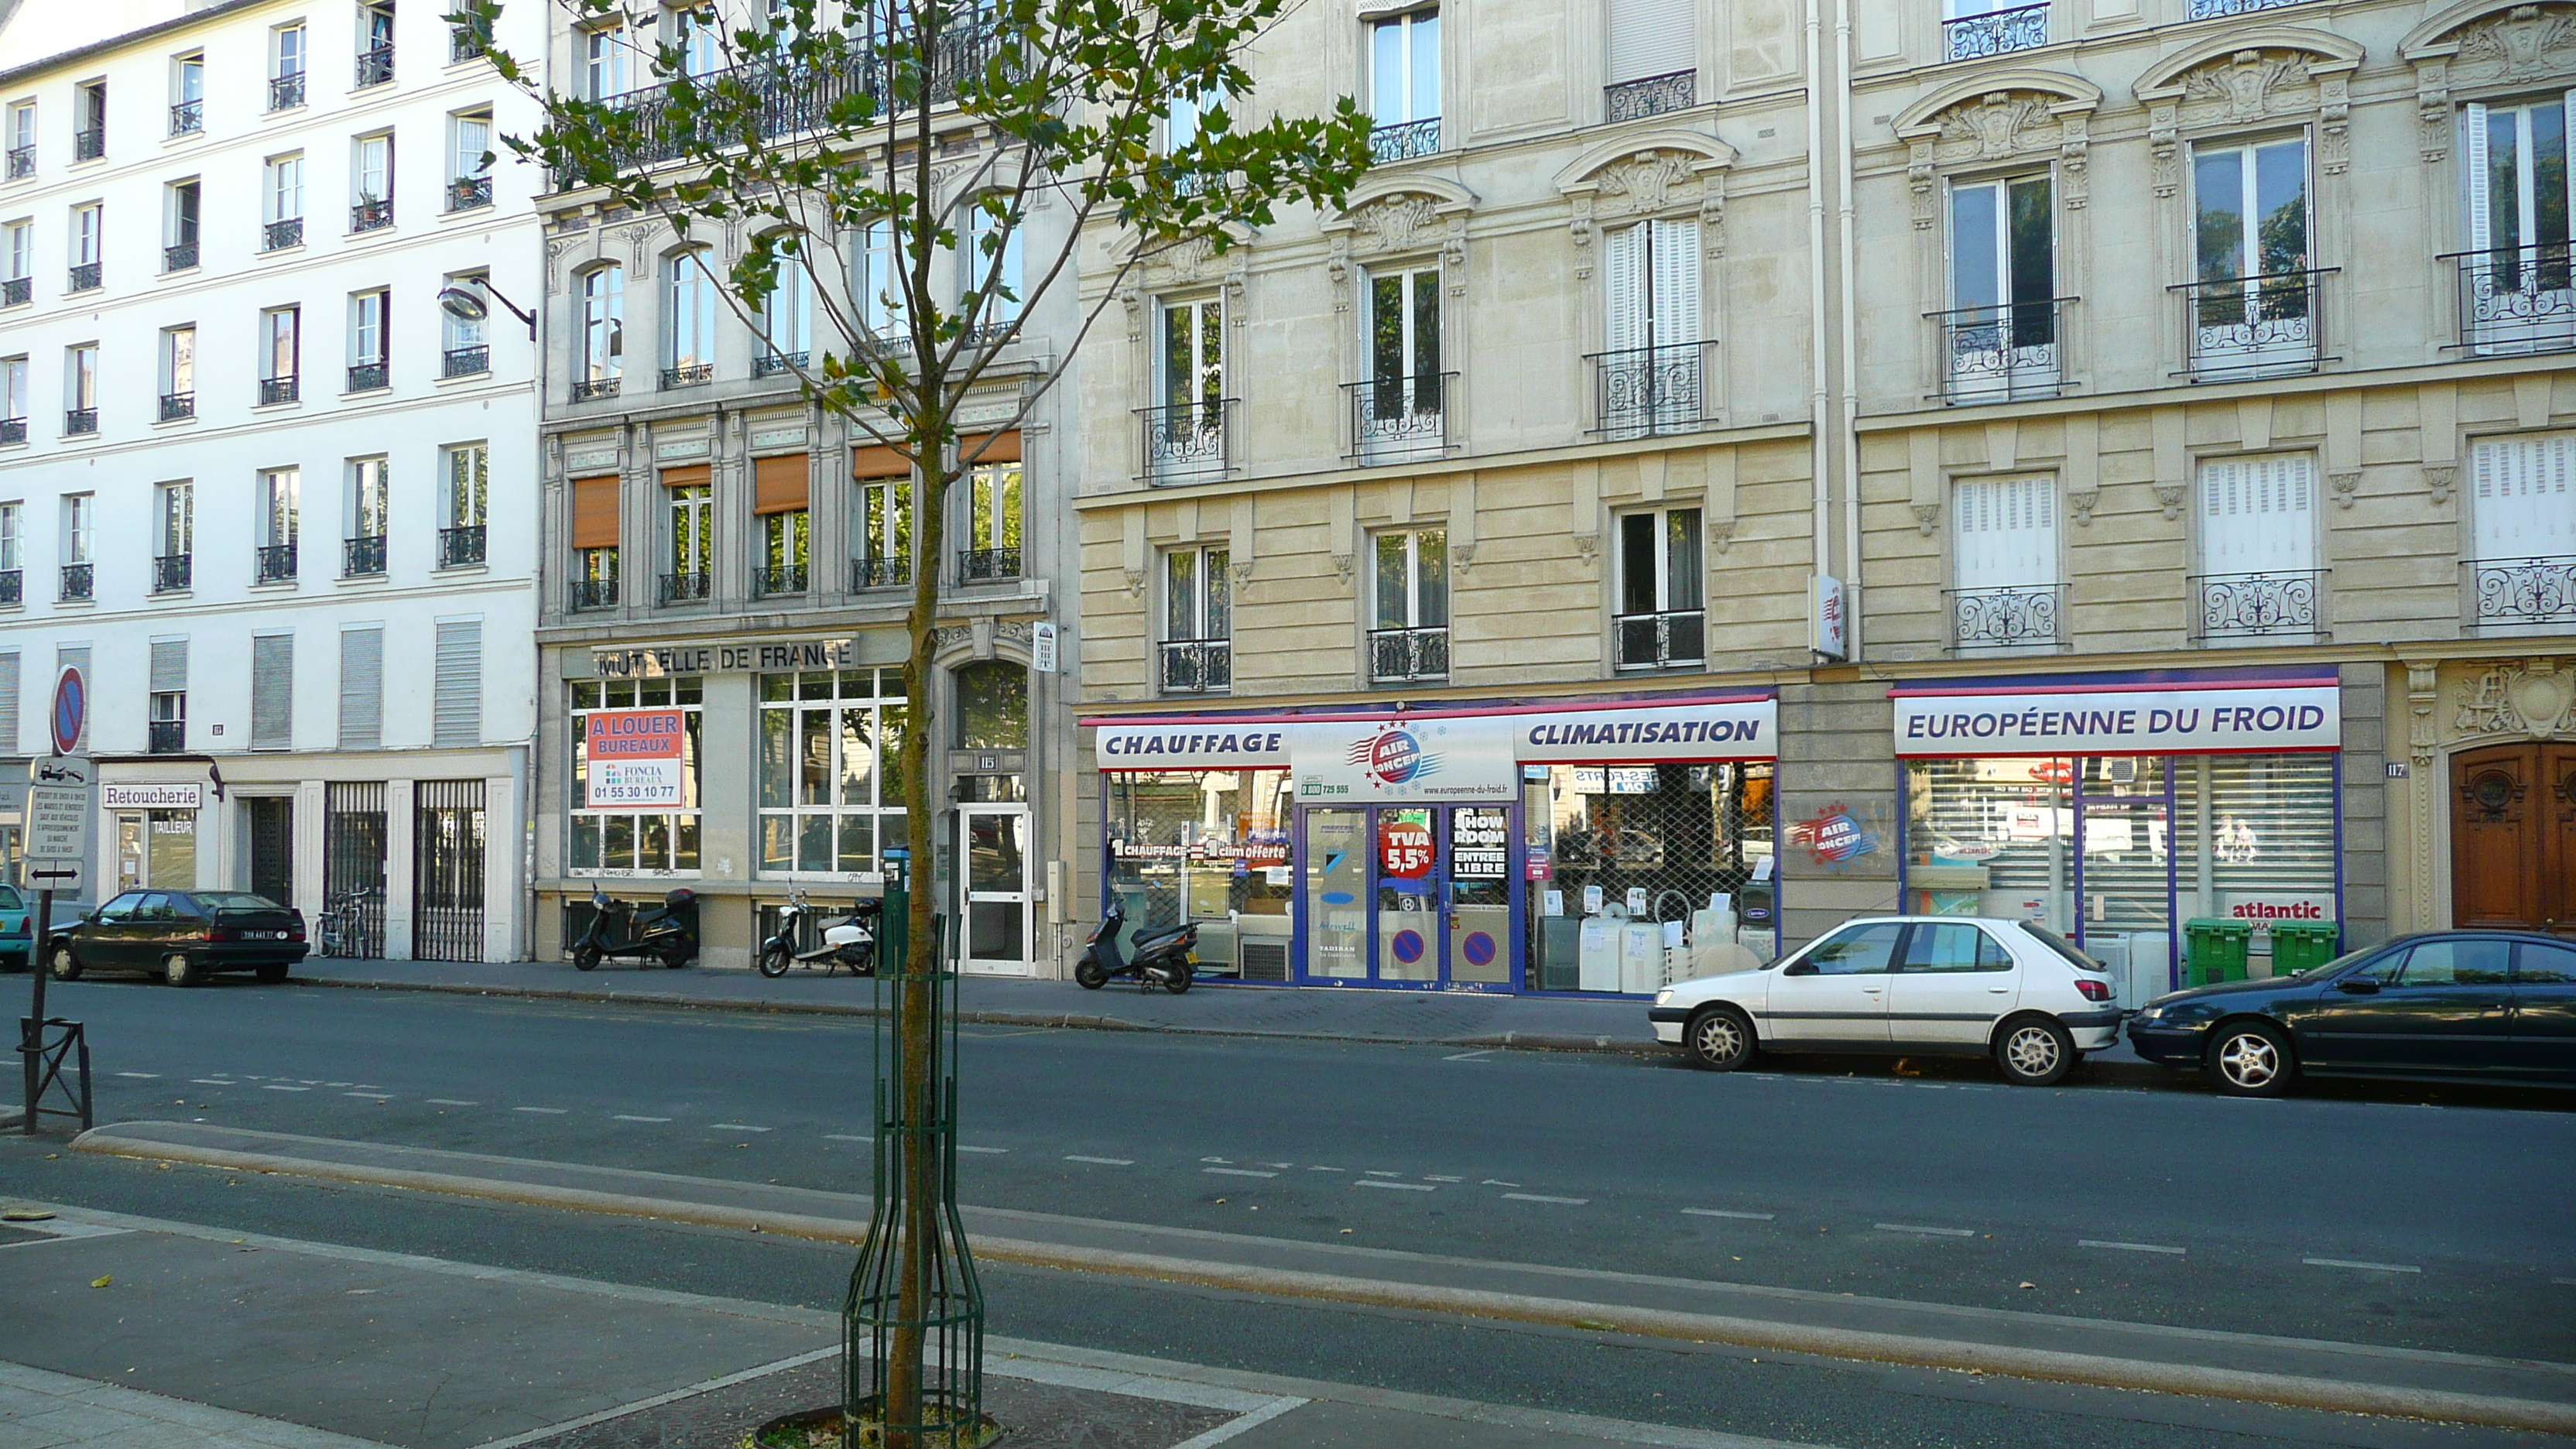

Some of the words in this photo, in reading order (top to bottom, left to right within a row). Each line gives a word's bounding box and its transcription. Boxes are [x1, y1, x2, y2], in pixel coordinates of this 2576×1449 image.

[599, 650, 710, 676] MUTELLE
[721, 649, 748, 669] DE
[592, 719, 605, 736] A
[611, 715, 678, 735] LOUER
[1906, 707, 2136, 738] EUROPÉENNE
[2148, 708, 2199, 734] DU
[2212, 705, 2325, 732] FROID
[1529, 720, 1760, 745] CLIMATISATION
[598, 738, 670, 754] BUREAUX
[1105, 733, 1282, 755] CHAUFFAGE
[1379, 740, 1410, 759] AIR
[981, 756, 995, 769] 115
[625, 766, 662, 776] FONCIA
[2388, 764, 2404, 776] 117
[107, 787, 196, 803] Retoucherie
[594, 786, 607, 798] 01
[611, 786, 624, 797] 55
[628, 786, 640, 797] 30
[645, 786, 657, 797] 10
[661, 786, 674, 796] 77
[1302, 786, 1307, 794] 0
[1323, 785, 1335, 794] 725
[1337, 785, 1349, 793] 555
[1424, 783, 1508, 796] www.europeenne-du-froid.fr
[154, 821, 193, 834] TAILLEUR
[1454, 816, 1504, 828] SHOW
[1821, 822, 1851, 838] AIR
[1388, 832, 1430, 846] TVA
[1454, 831, 1505, 844] ROOM
[1112, 839, 1123, 856] 1
[1125, 845, 1187, 856] CHAUFFAGE
[1205, 838, 1218, 857] 1
[1219, 845, 1245, 857] clim
[1245, 844, 1286, 858] offerte
[1958, 846, 1992, 855] atlantic
[1388, 849, 1430, 872] 5,5%
[1454, 852, 1506, 862] ENTREE
[1454, 863, 1506, 873] LIBRE
[2232, 900, 2321, 919] atlantic
